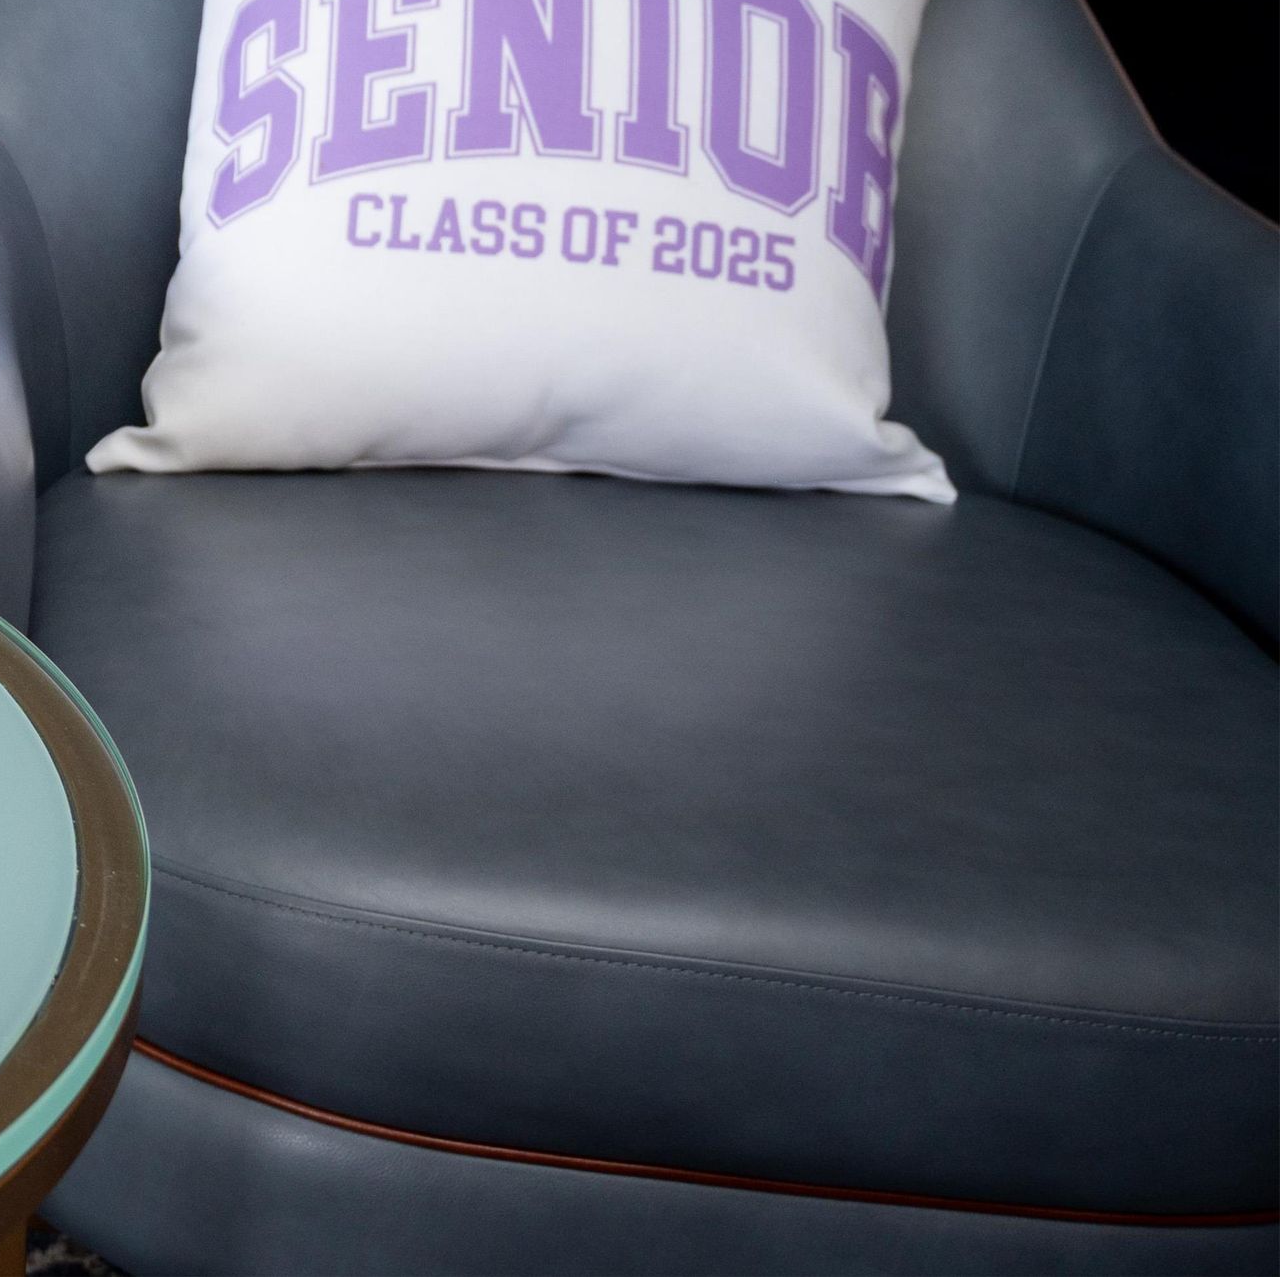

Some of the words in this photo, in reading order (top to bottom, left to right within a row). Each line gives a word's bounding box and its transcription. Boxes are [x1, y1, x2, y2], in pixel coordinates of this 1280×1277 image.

[346, 192, 547, 260] CLASS
[560, 206, 638, 269] OF
[651, 216, 796, 293] 2025
